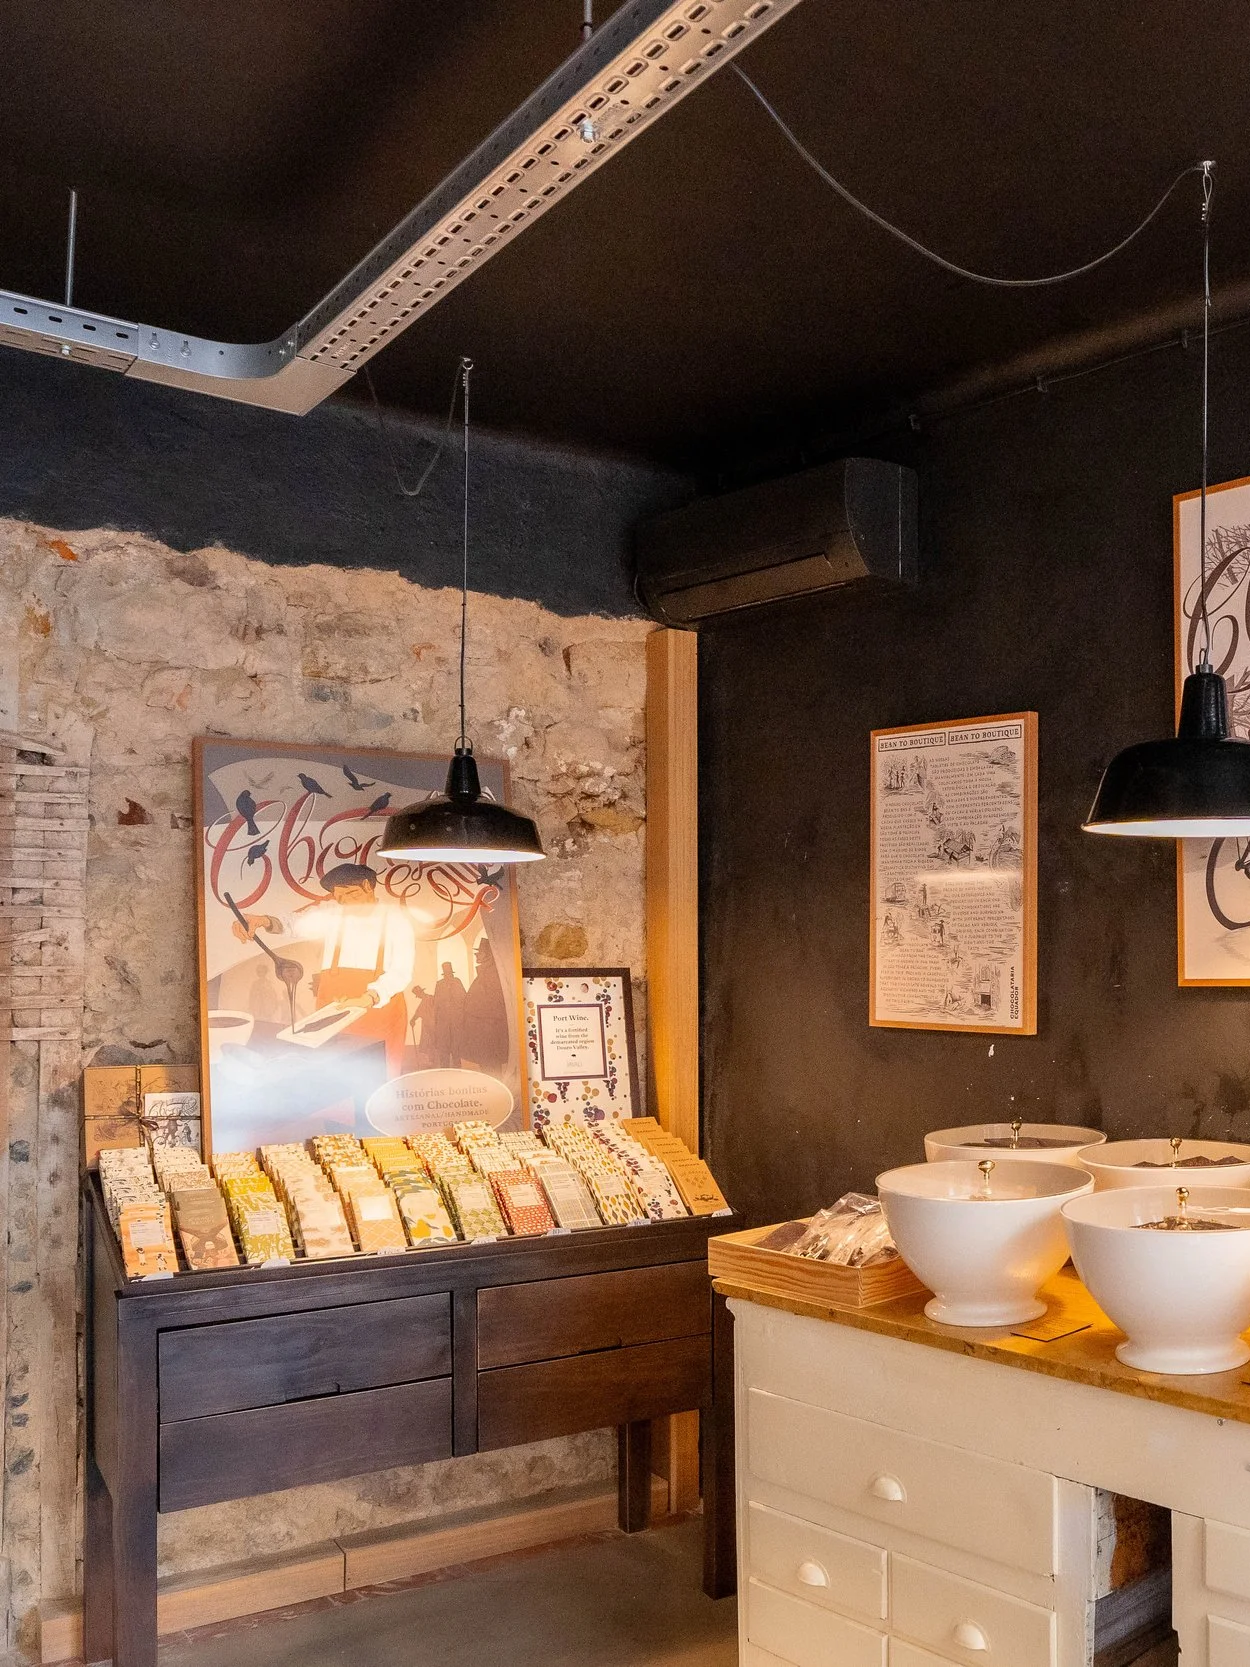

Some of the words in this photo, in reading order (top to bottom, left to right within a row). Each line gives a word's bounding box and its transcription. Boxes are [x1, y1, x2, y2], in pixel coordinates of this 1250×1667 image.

[950, 733, 968, 741] BEAN
[971, 731, 980, 739] TO
[982, 728, 1019, 738] BOUTIQUE
[909, 736, 944, 747] BOUTIQUE
[396, 1088, 445, 1099] Histórias
[449, 1085, 488, 1096] bonitas
[402, 1103, 425, 1112] com
[427, 1099, 482, 1110] Chocolate.
